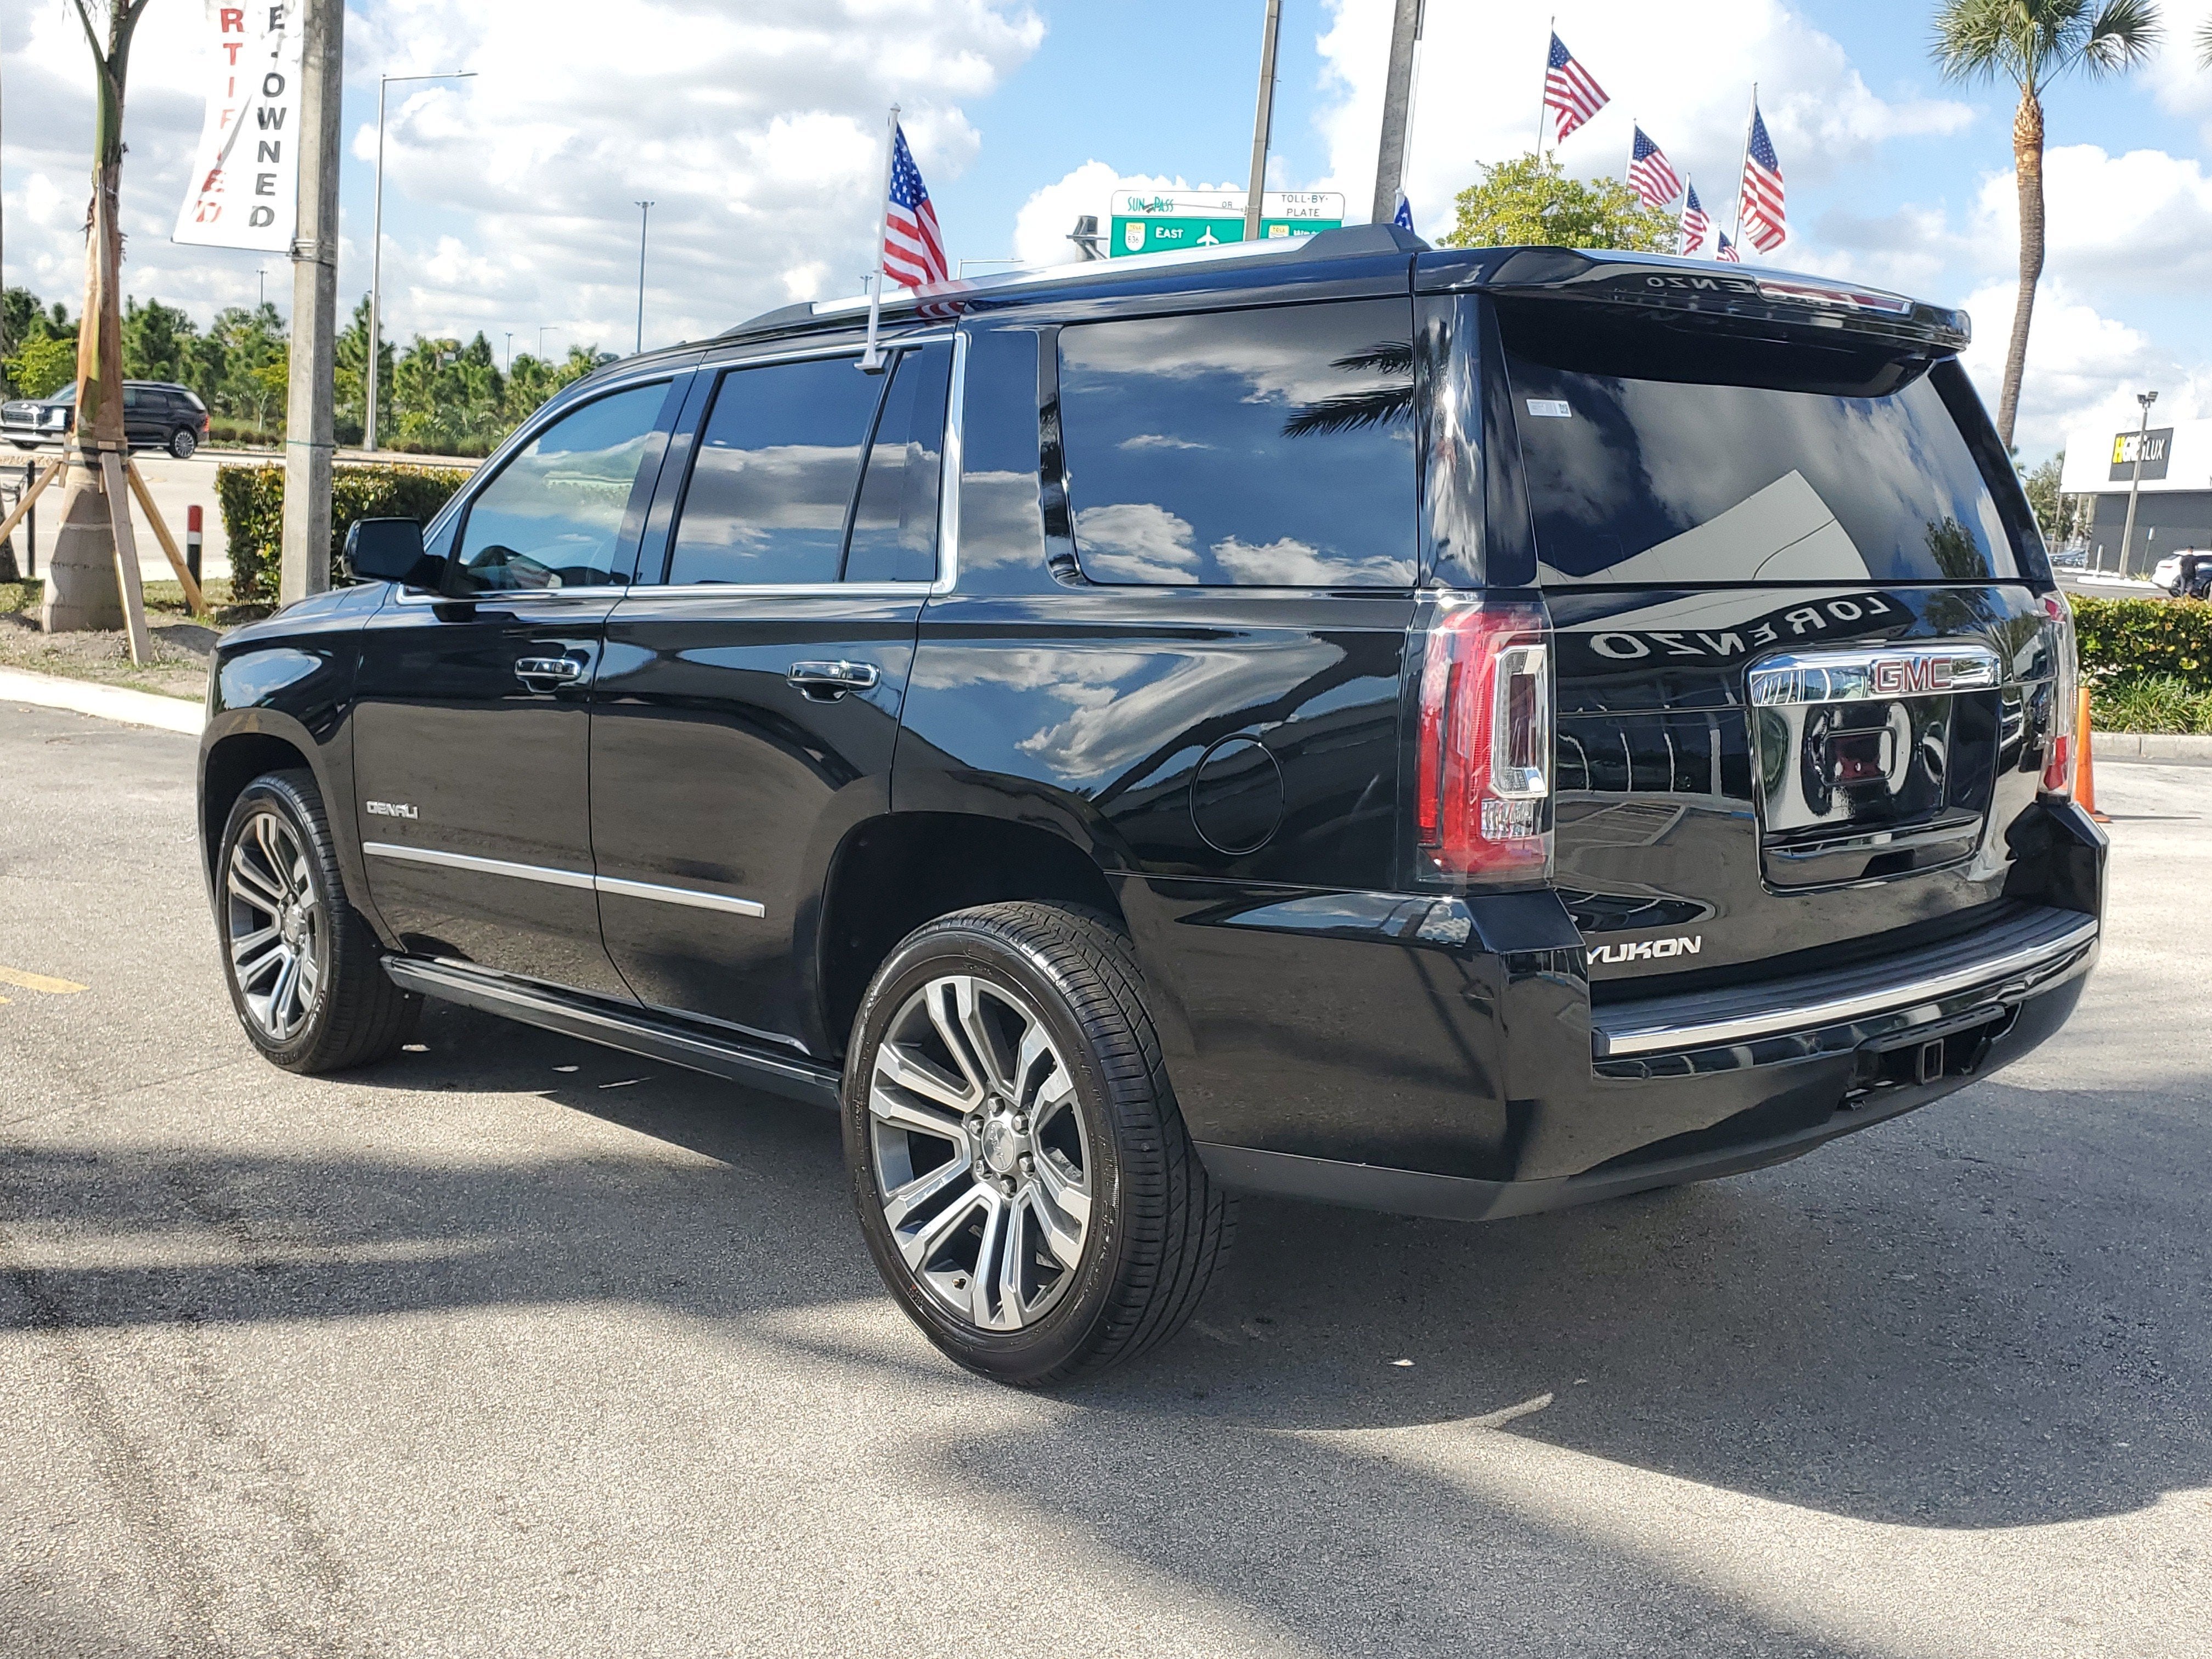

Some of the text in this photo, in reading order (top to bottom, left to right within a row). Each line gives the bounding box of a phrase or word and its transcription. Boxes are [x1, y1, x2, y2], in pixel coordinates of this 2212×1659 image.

[1286, 208, 1321, 217] PLATE
[1155, 226, 1184, 239] EAST
[1876, 657, 1953, 694] GMC
[366, 800, 419, 820] DENALI
[1587, 935, 1701, 965] YUKON
